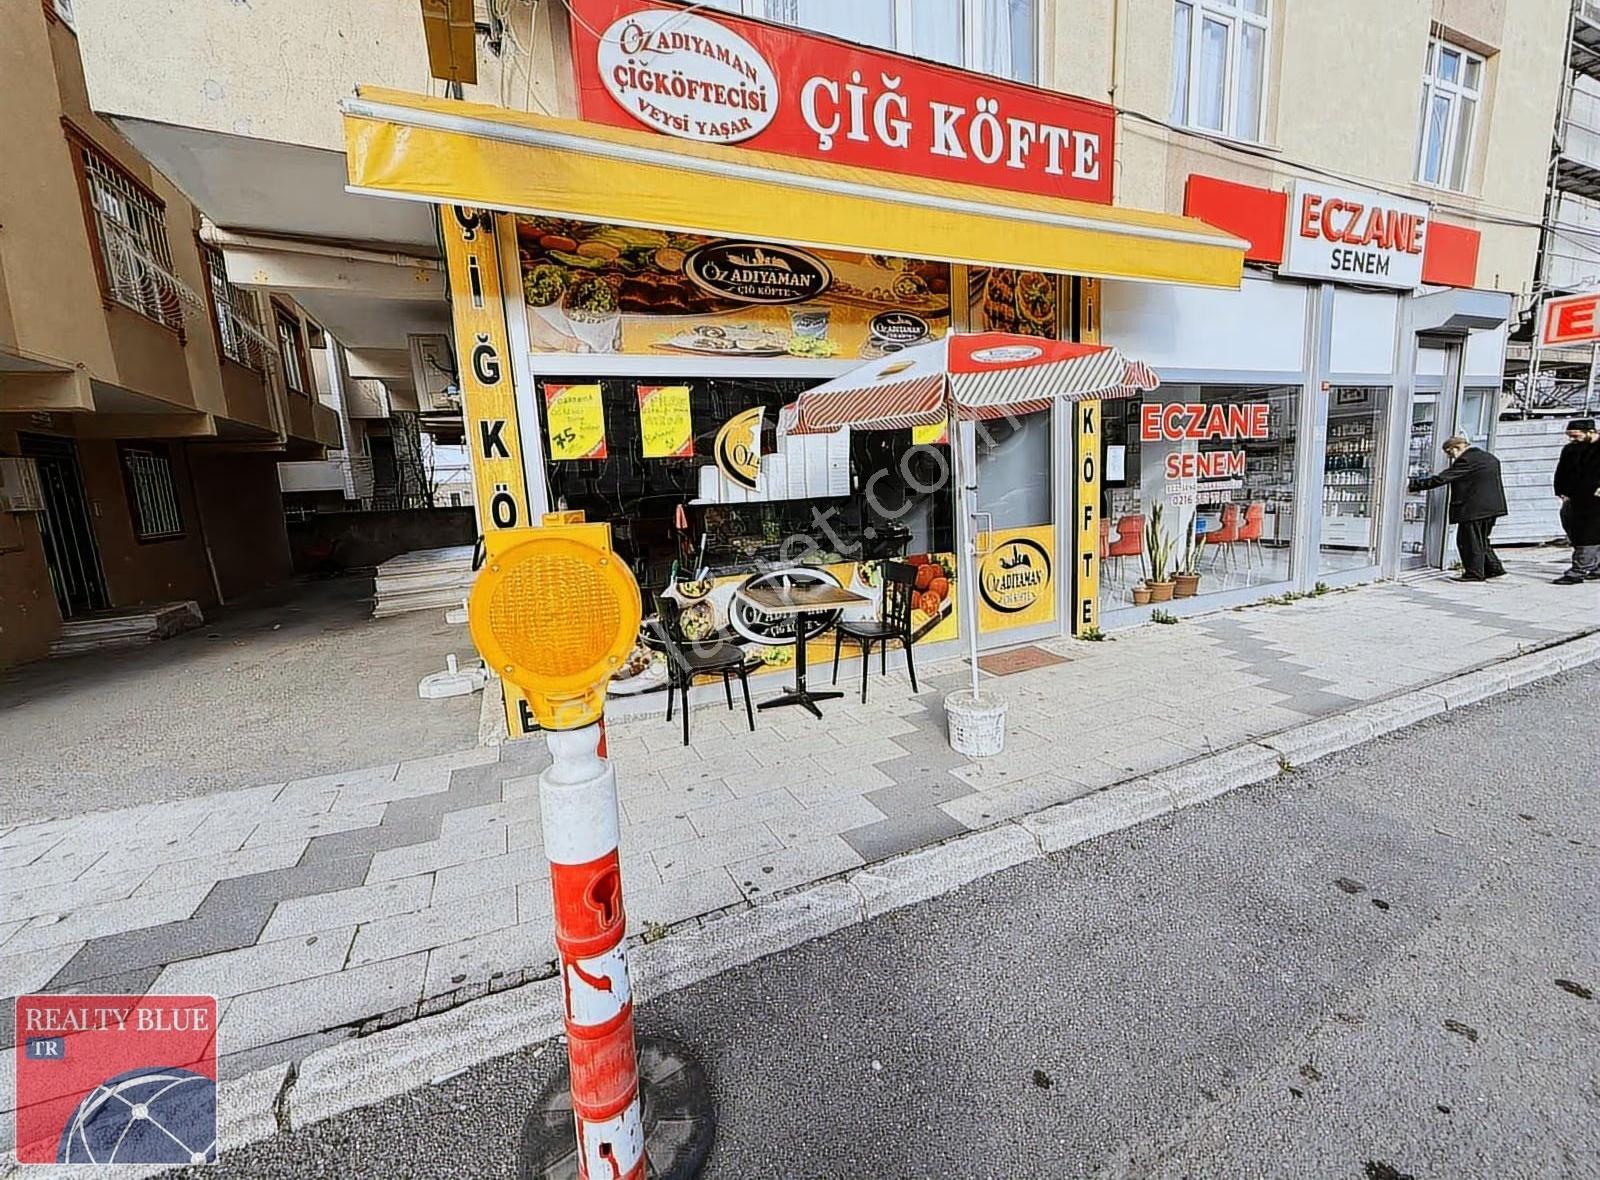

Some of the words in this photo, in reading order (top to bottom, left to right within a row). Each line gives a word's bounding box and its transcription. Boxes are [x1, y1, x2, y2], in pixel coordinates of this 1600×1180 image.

[657, 32, 757, 85] ADIYAMAN
[637, 97, 690, 132] VEYSİ
[695, 117, 753, 140] YAŞAR
[800, 70, 913, 151] ÇİĞ
[929, 96, 1100, 181] KÖFTE
[1299, 192, 1426, 256] ECZANE
[731, 268, 811, 287] ADIYAMAN
[1330, 248, 1391, 276] SENEM
[1140, 403, 1270, 442] ECZANE
[1165, 451, 1246, 479] SENEM
[1082, 406, 1095, 624] KÖFTE
